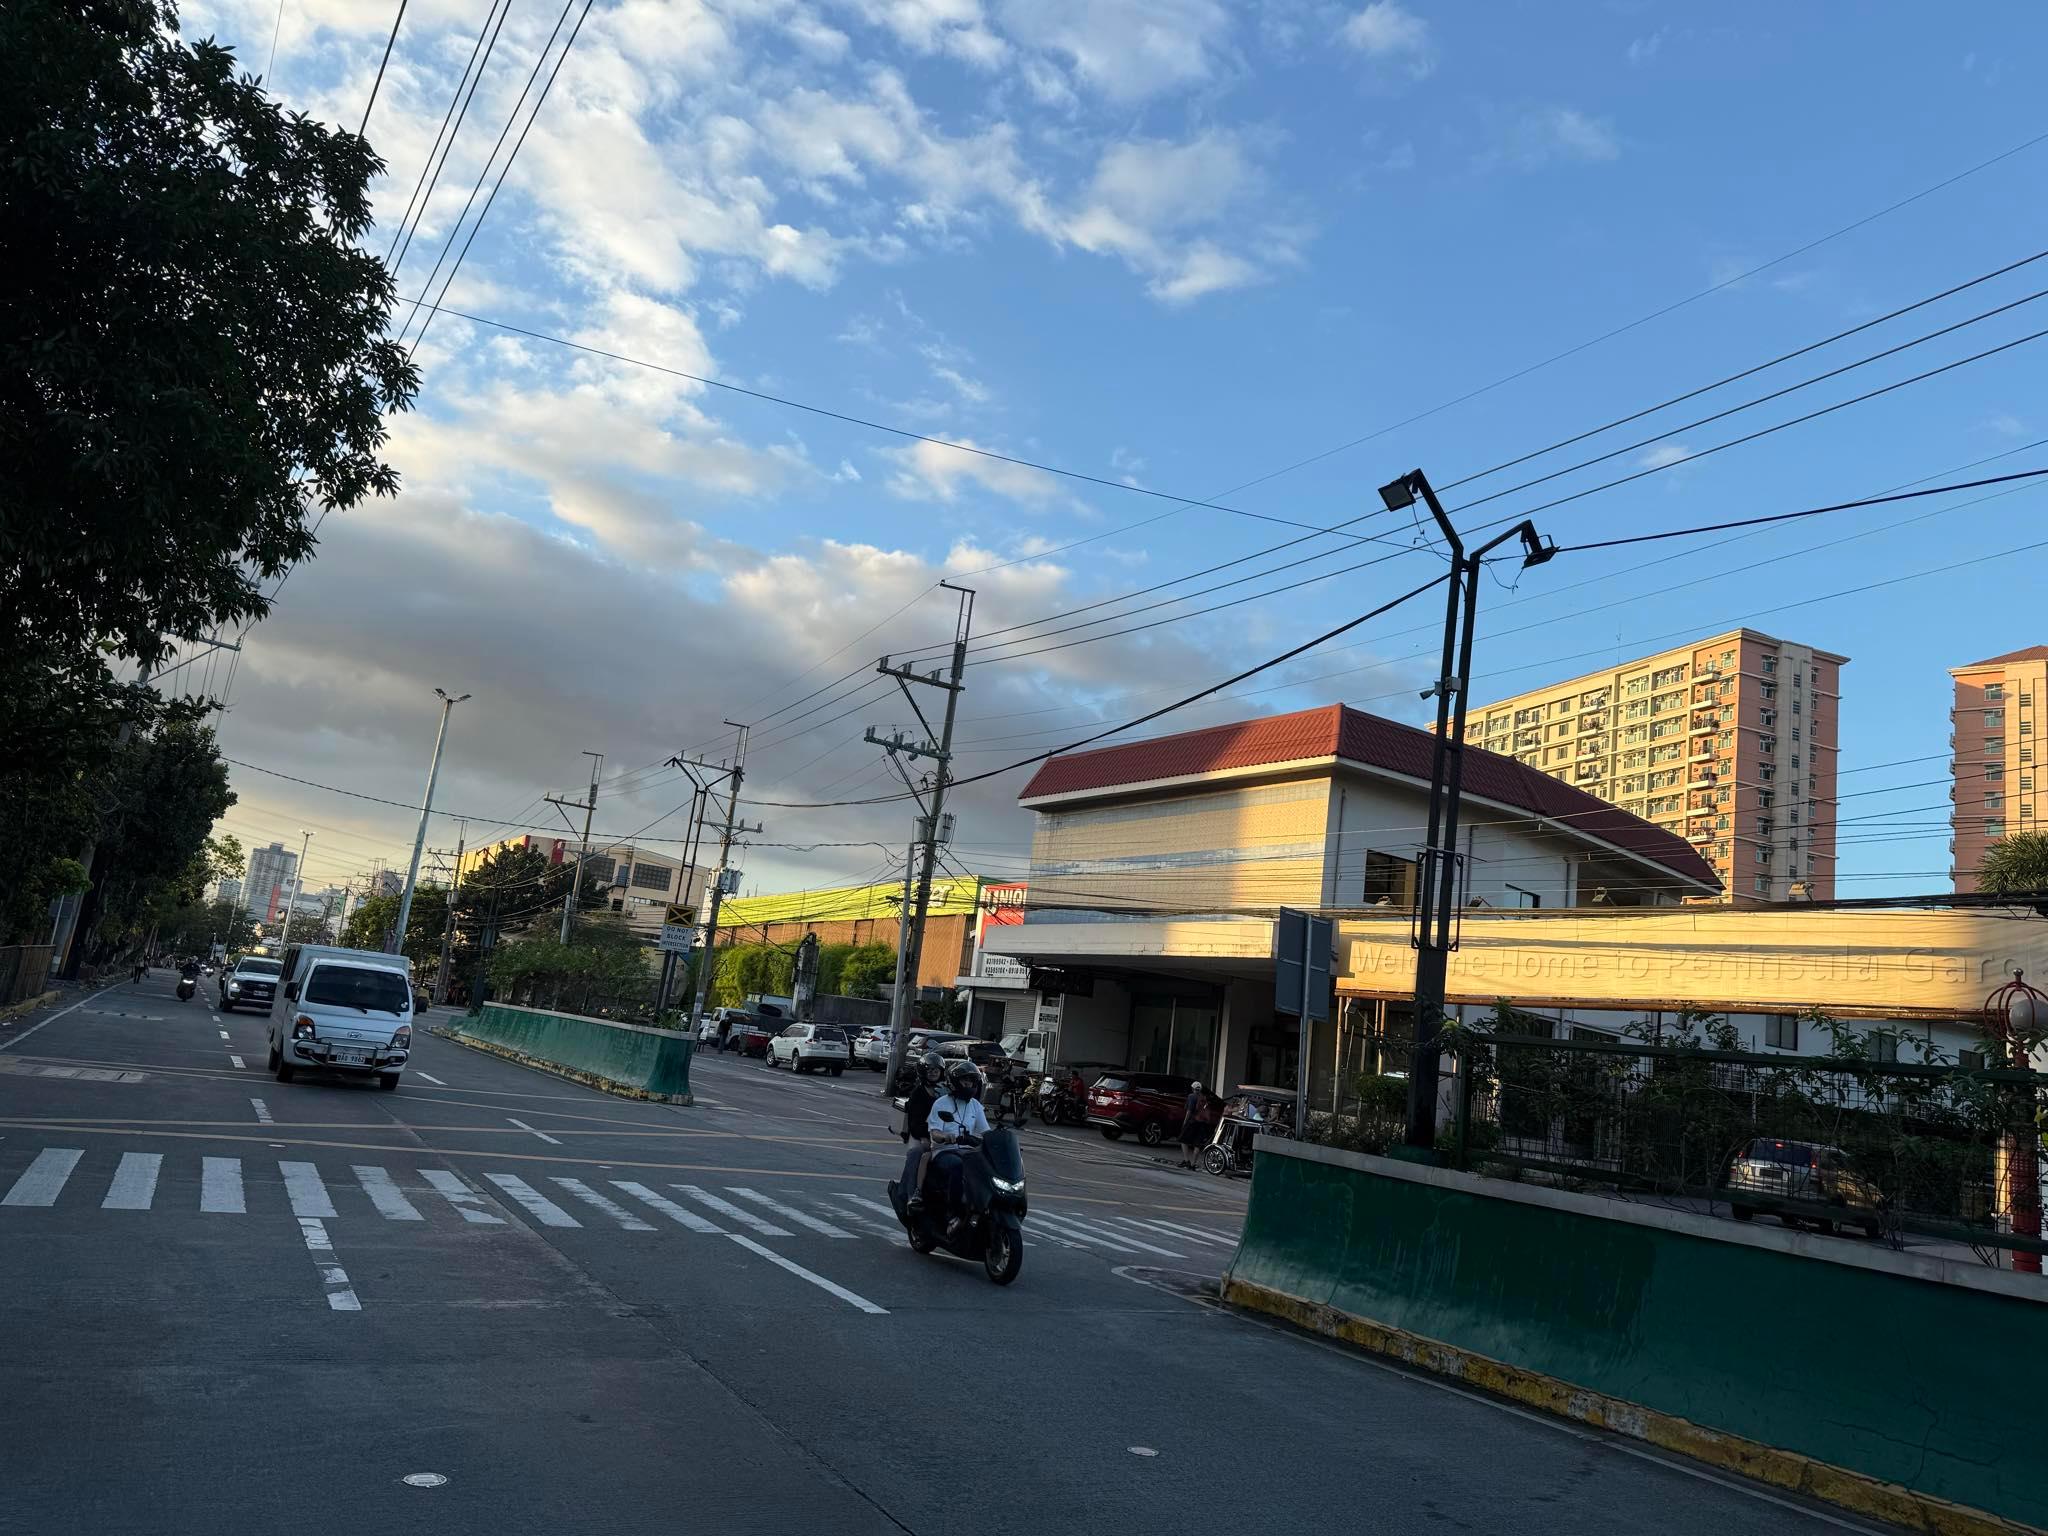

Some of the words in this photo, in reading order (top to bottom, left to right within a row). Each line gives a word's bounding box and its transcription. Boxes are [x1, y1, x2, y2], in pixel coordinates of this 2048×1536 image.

[667, 933, 685, 941] BLOCK
[1498, 948, 1600, 979] Home
[1615, 949, 1650, 979] to
[1664, 945, 1880, 983] Peninsula
